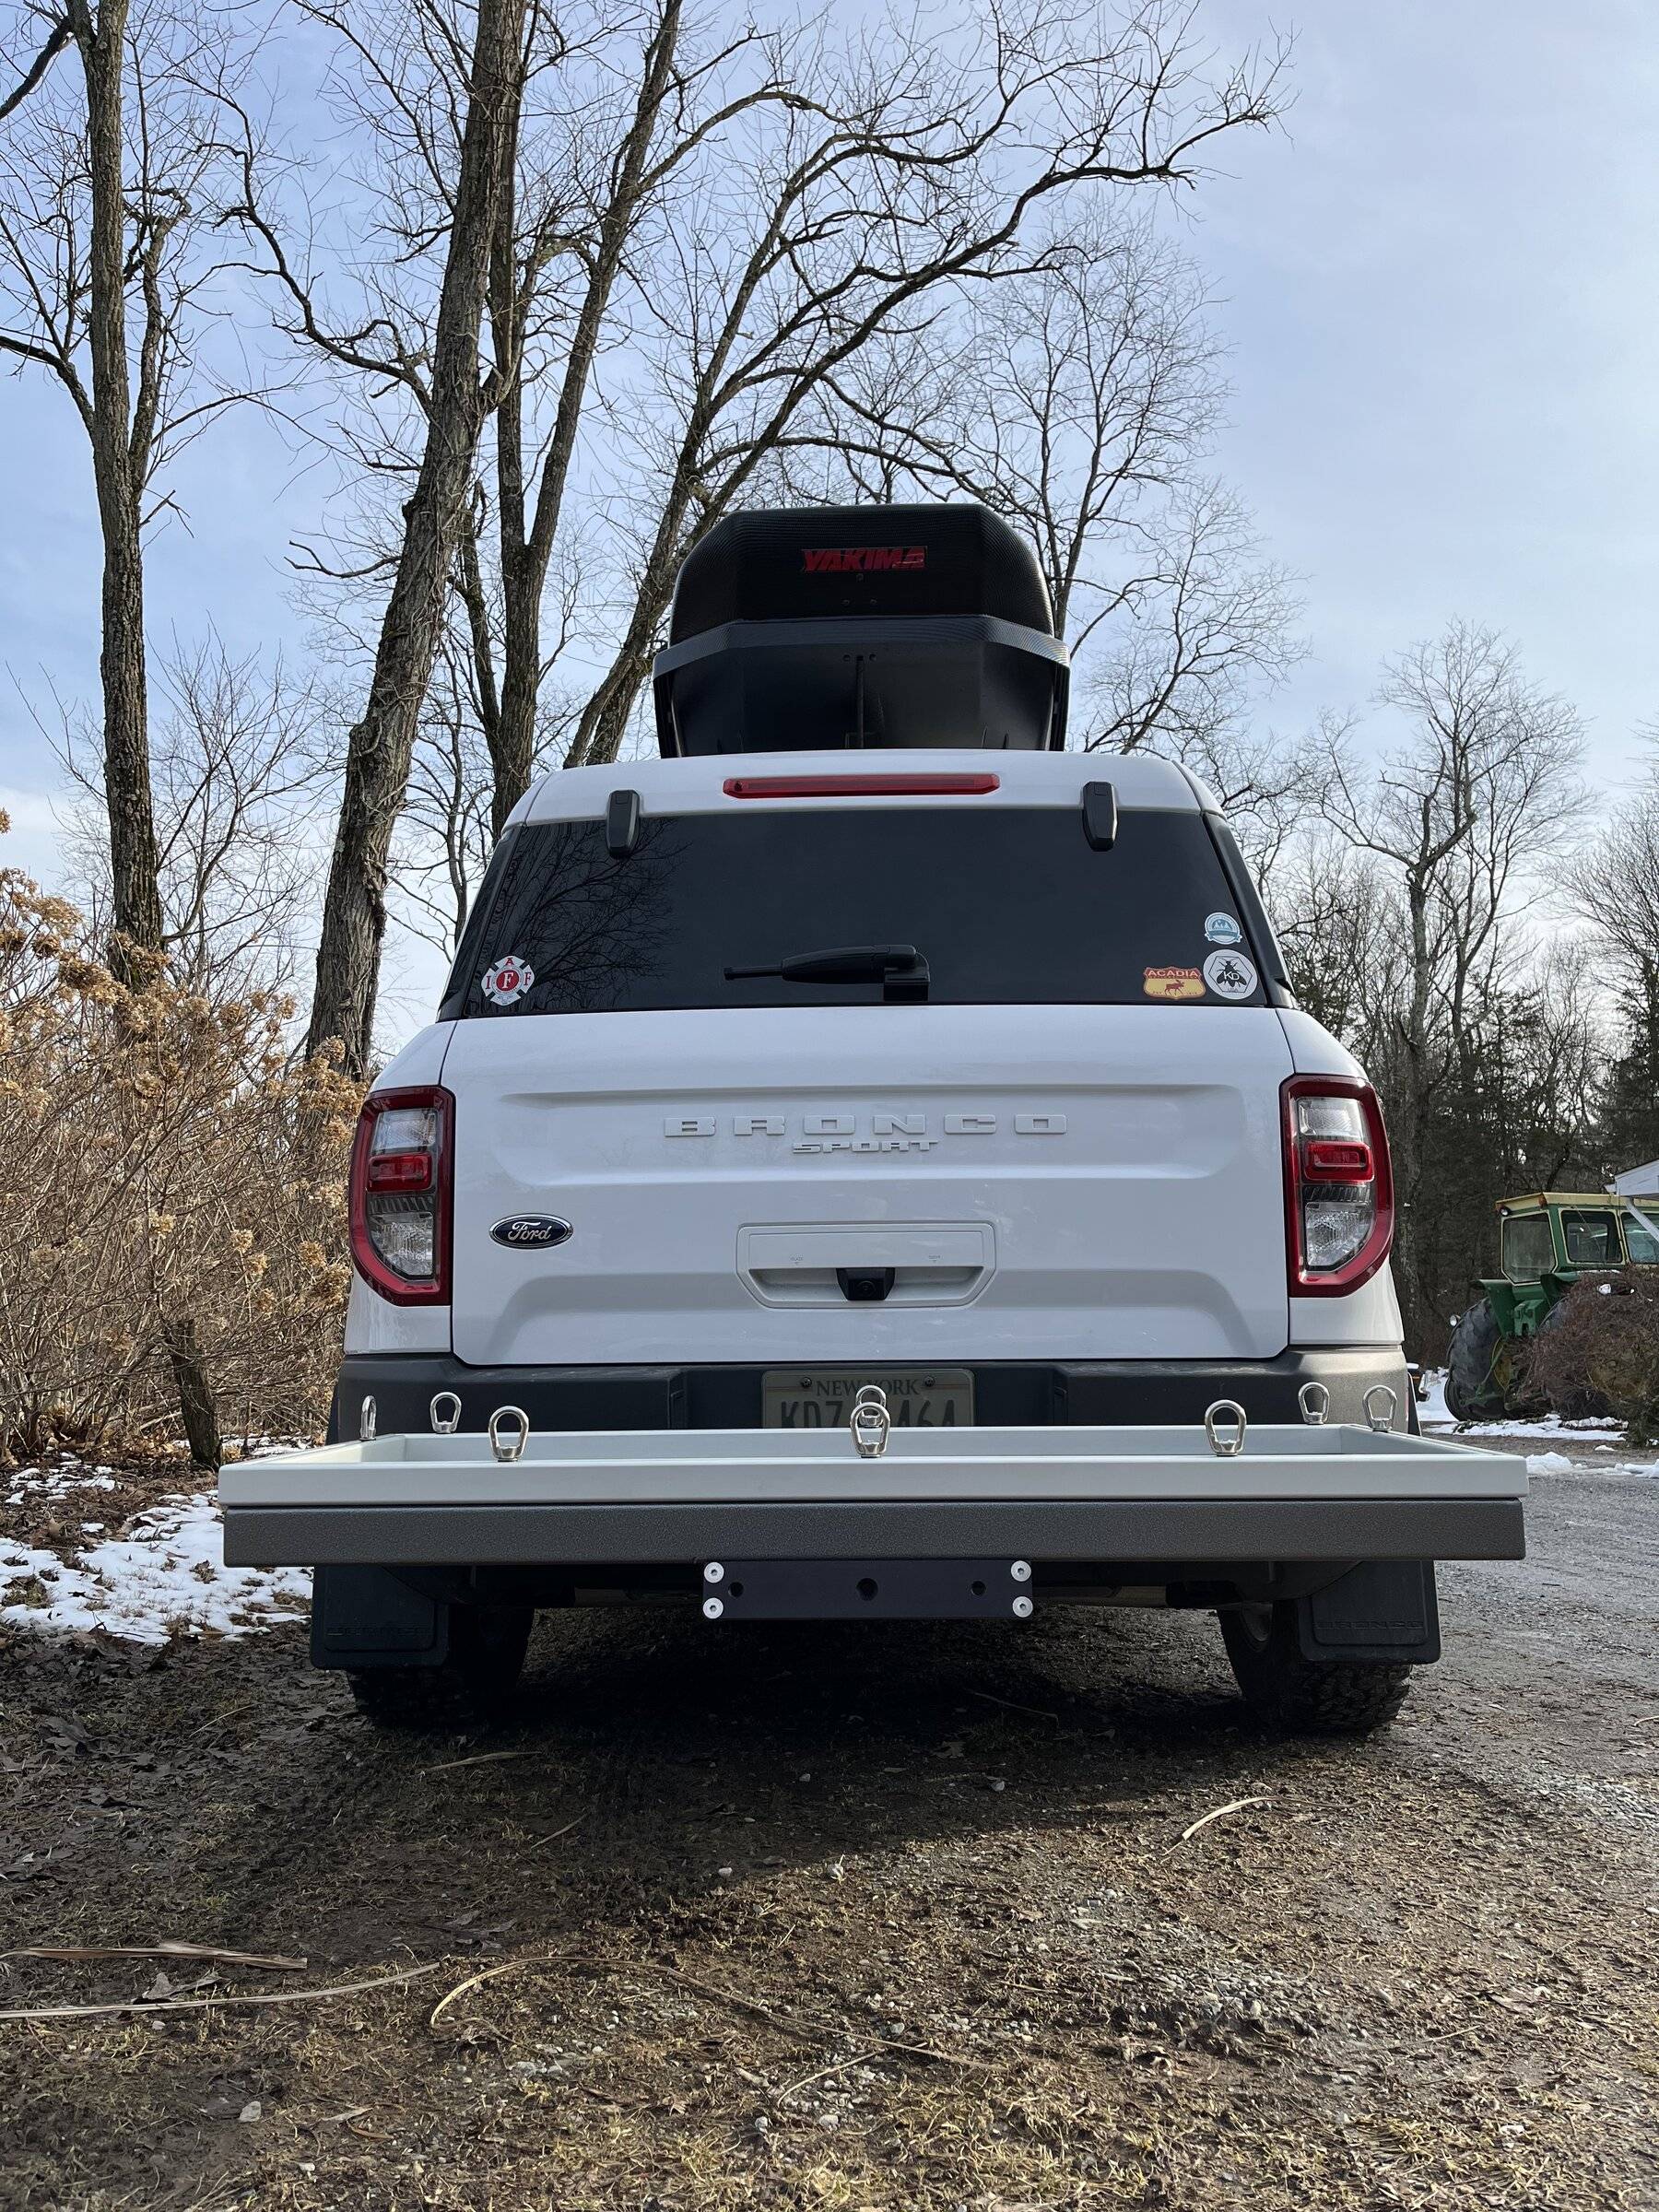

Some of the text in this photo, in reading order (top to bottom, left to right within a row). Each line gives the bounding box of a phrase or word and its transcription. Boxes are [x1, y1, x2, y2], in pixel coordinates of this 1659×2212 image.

[803, 547, 926, 571] YAKIMA
[1223, 971, 1240, 981] KD
[664, 1113, 1067, 1136] BRONCO
[793, 1140, 939, 1153] SPORT
[507, 1221, 552, 1241] Ford
[817, 1380, 861, 1396] NEW
